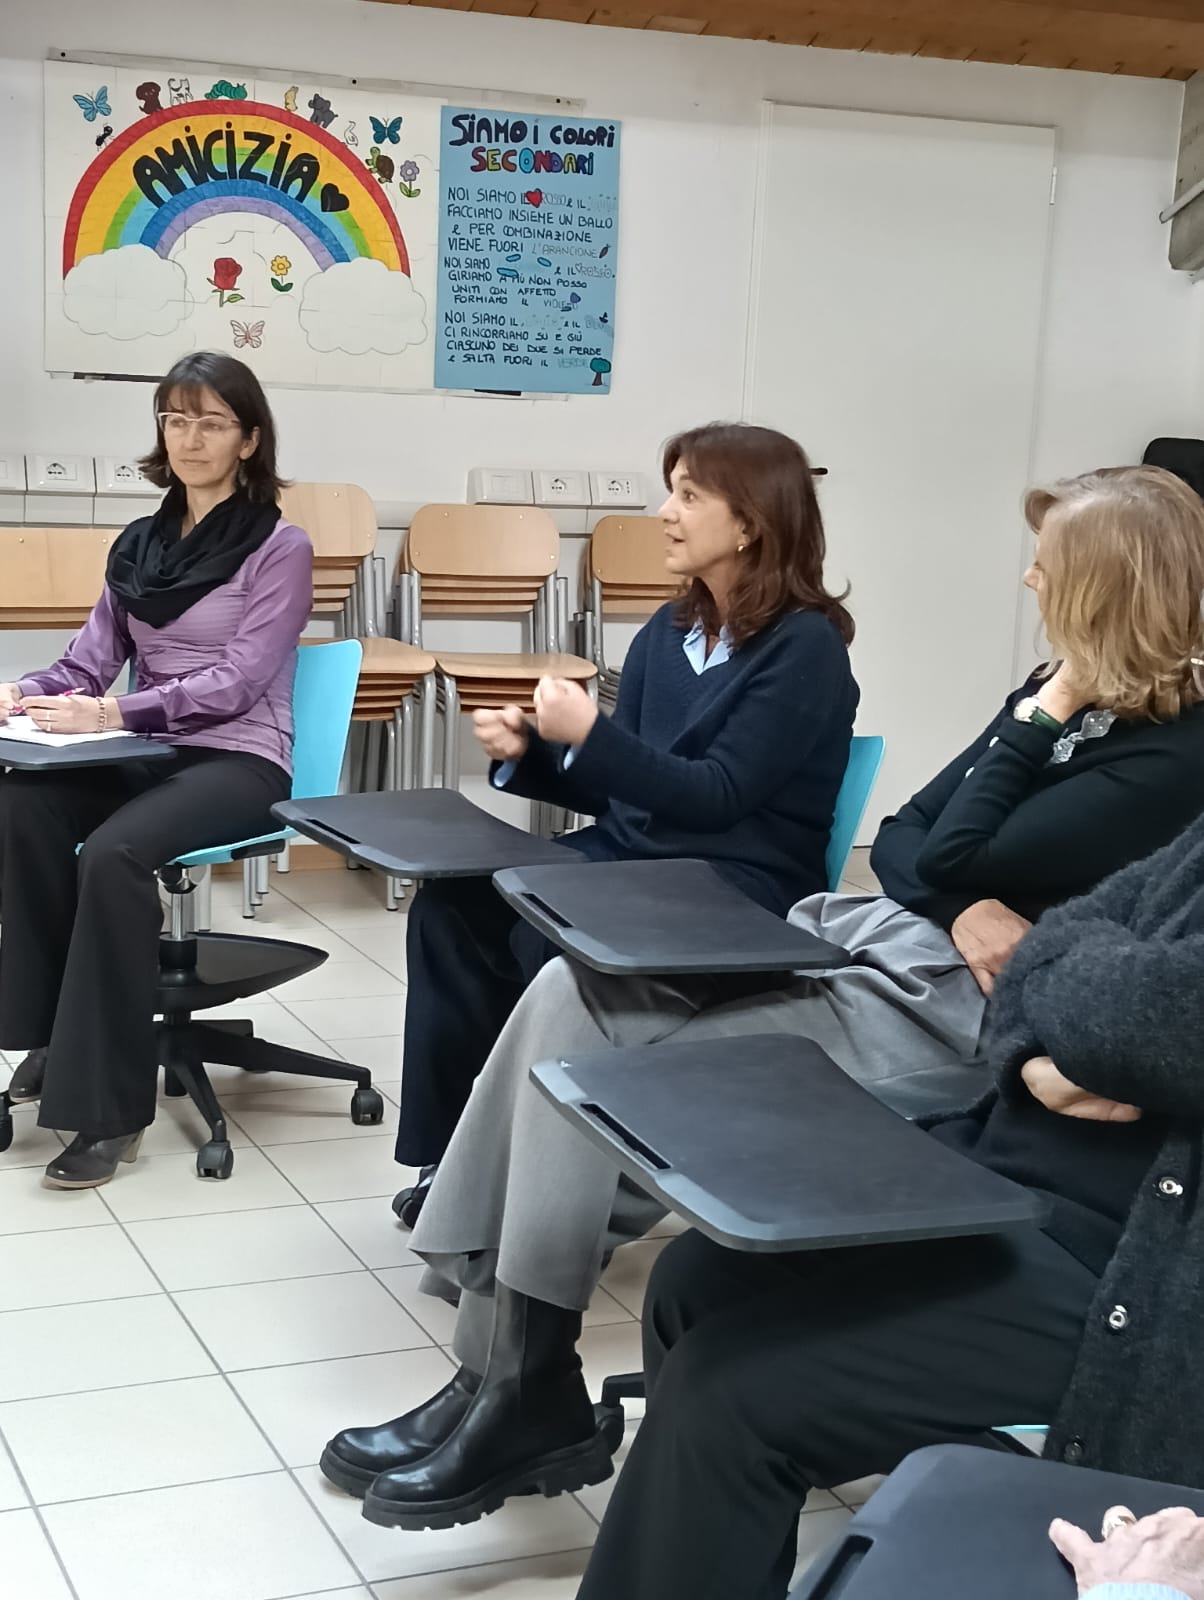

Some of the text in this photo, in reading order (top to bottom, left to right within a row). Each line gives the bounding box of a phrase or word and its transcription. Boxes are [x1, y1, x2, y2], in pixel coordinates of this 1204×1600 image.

[448, 187, 469, 201] NOI
[477, 188, 516, 204] SIAMO
[578, 200, 586, 209] IL
[448, 204, 612, 229] FACCIAMO INSIEME UN BALLO
[469, 223, 495, 236] PER
[503, 227, 592, 243] COMBINAZIONE
[448, 238, 483, 252] VIENE
[489, 240, 523, 253] FUORI
[444, 257, 461, 268] NOI
[464, 258, 490, 270] SIAMO
[568, 267, 576, 276] IL
[448, 270, 492, 282] GIRIAMO
[529, 275, 551, 286] NON
[557, 278, 587, 288] POSSO
[452, 285, 556, 296] UNITI CON AFFETTO
[454, 295, 508, 304] FORMIAMO
[445, 312, 465, 323] NOI
[472, 313, 506, 326] SIAMO
[510, 317, 518, 327] IL
[444, 328, 455, 338] CI
[461, 329, 529, 341] RINCORRIAMO
[447, 341, 496, 350] CIASCUNO
[503, 343, 519, 352] DEI
[528, 344, 548, 354] DUE
[462, 355, 495, 363] SALTA
[504, 356, 532, 366] FUORI
[541, 359, 548, 367] IL
